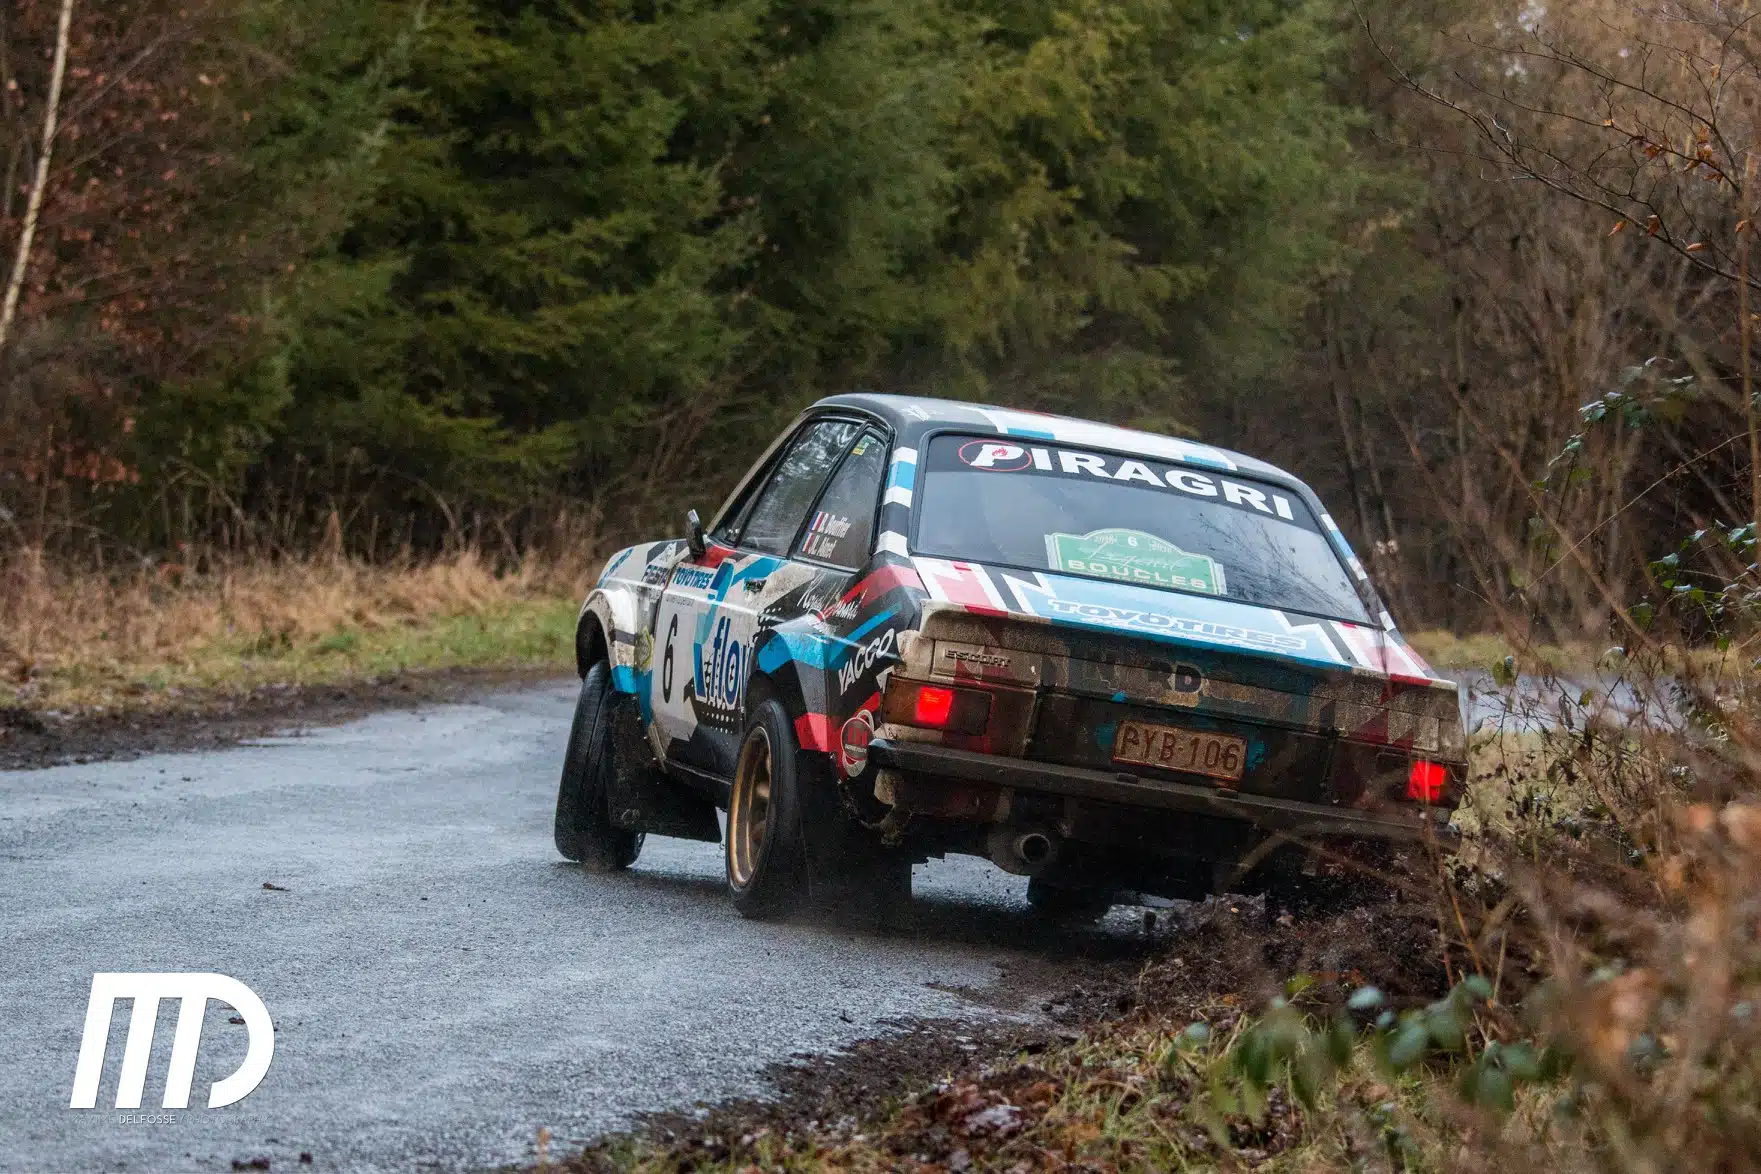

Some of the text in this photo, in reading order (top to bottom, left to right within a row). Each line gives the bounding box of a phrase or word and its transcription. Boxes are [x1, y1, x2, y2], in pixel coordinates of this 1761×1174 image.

[968, 443, 1295, 521] PIRAGRI
[1127, 535, 1139, 547] 6
[1068, 559, 1207, 589] BOUCLES
[662, 613, 678, 704] 6
[838, 628, 895, 696] YACCO
[944, 649, 1010, 668] ESCORT
